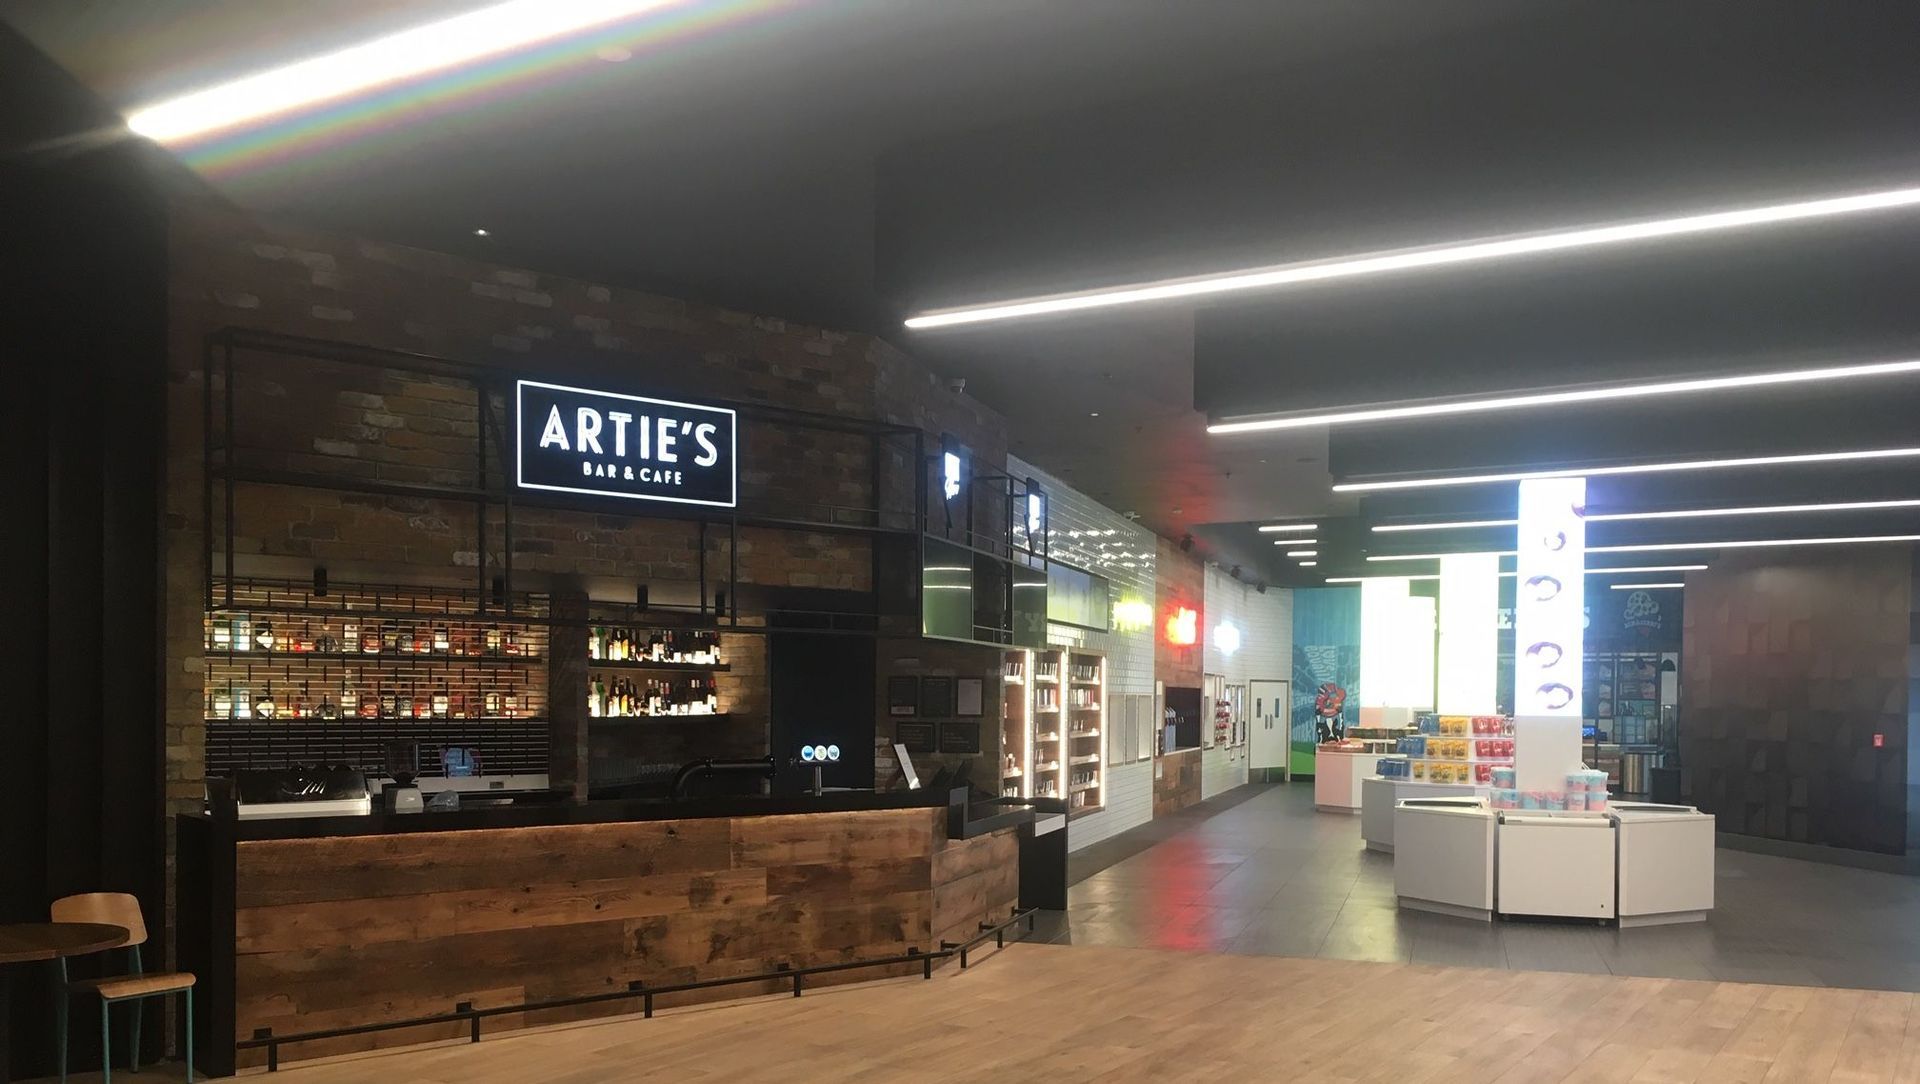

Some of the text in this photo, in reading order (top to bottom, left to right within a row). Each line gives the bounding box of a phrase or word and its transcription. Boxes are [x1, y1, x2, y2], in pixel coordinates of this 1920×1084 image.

[540, 404, 718, 467] ARTIE'S
[583, 461, 681, 485] BAR & CAFE
